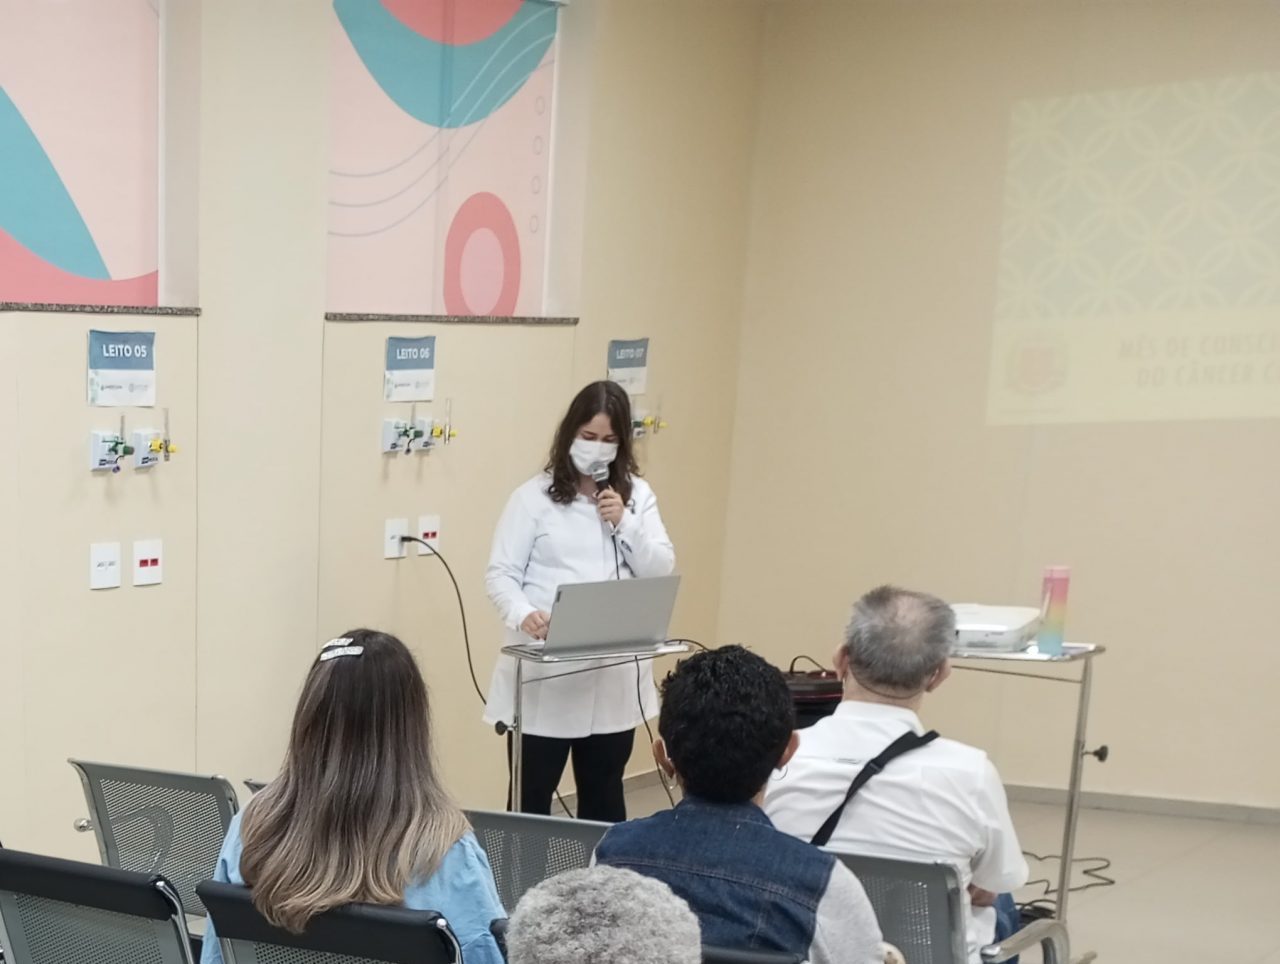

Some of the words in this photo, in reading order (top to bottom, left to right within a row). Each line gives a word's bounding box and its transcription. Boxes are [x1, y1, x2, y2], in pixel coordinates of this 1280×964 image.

[102, 344, 132, 357] LEITO
[134, 345, 147, 358] 05
[396, 347, 418, 360] LEITO
